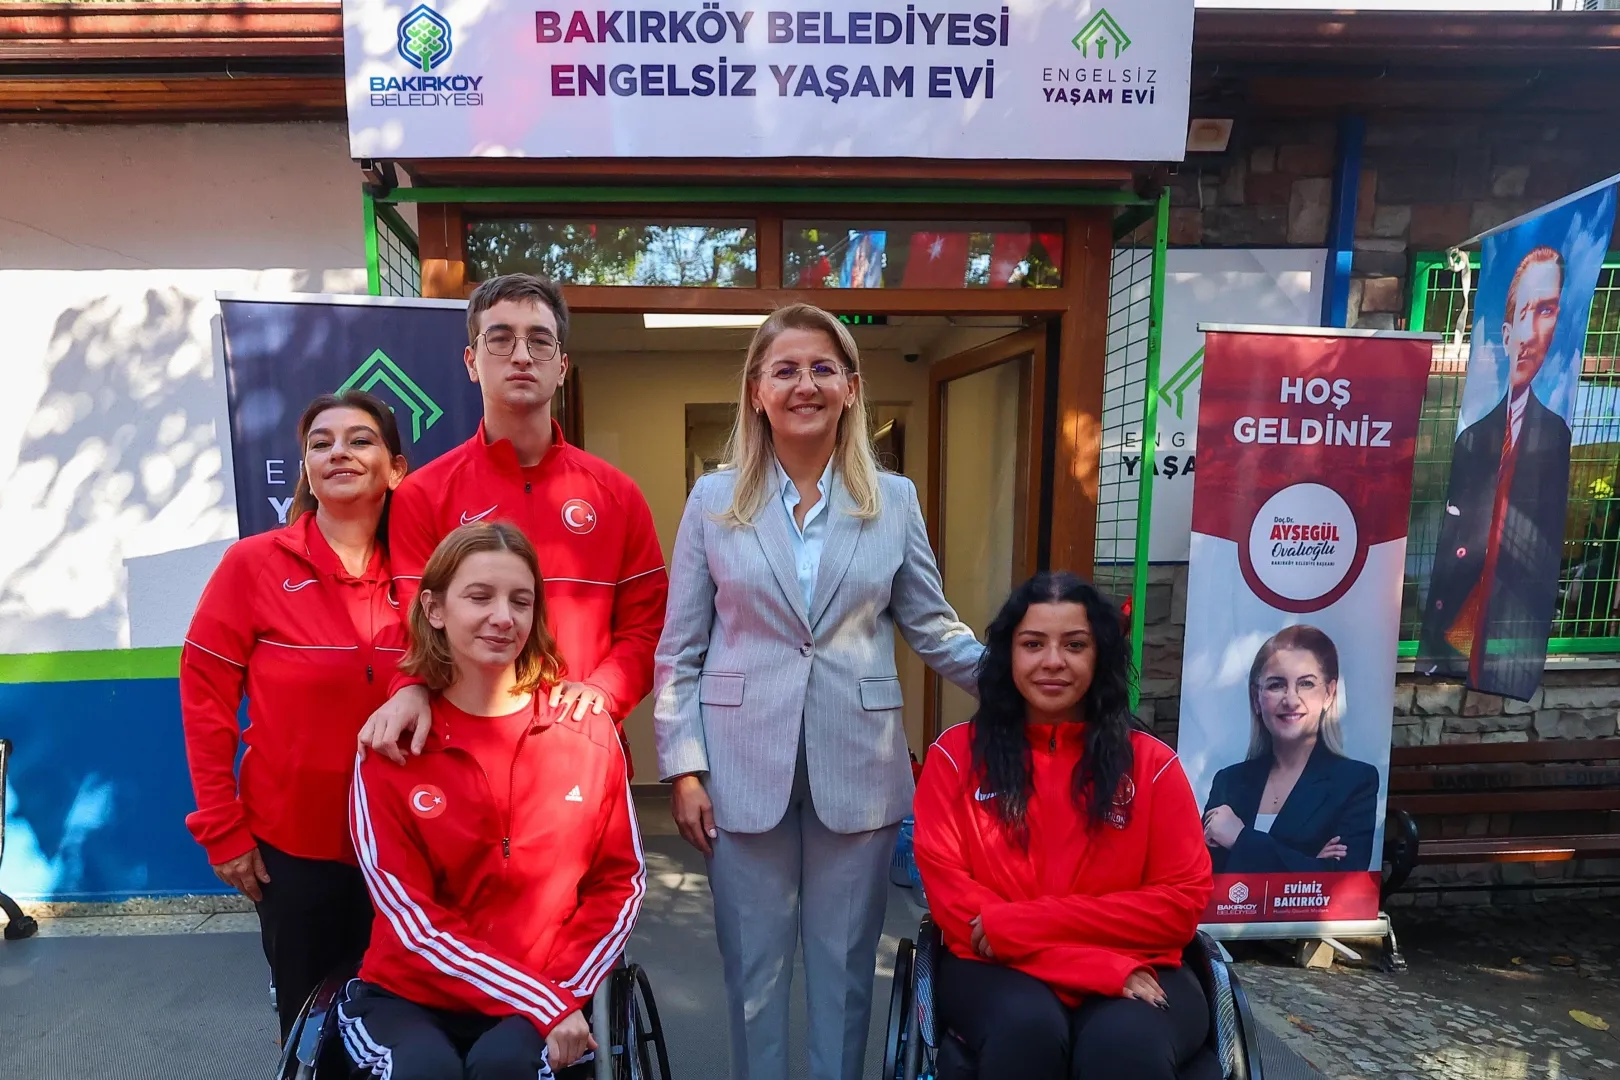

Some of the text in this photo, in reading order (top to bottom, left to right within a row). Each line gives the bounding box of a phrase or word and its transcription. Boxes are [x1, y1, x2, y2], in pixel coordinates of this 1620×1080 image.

[535, 2, 1009, 47] BAKIRKÖY BELEDİYESİ
[369, 73, 484, 91] BAKIRKÖY
[550, 56, 995, 104] ENGELSİZ YAŞAM EVİ
[1043, 65, 1157, 84] ENGELSİZ
[1043, 86, 1155, 106] YAŞAM EVİ
[1280, 376, 1351, 411] HOŞ
[1233, 413, 1394, 447] GELDİNİZ
[1269, 522, 1340, 543] AYŞEGÜL
[1284, 880, 1323, 894] EVİMİZ
[1273, 894, 1331, 907] BAKIRKÖY
